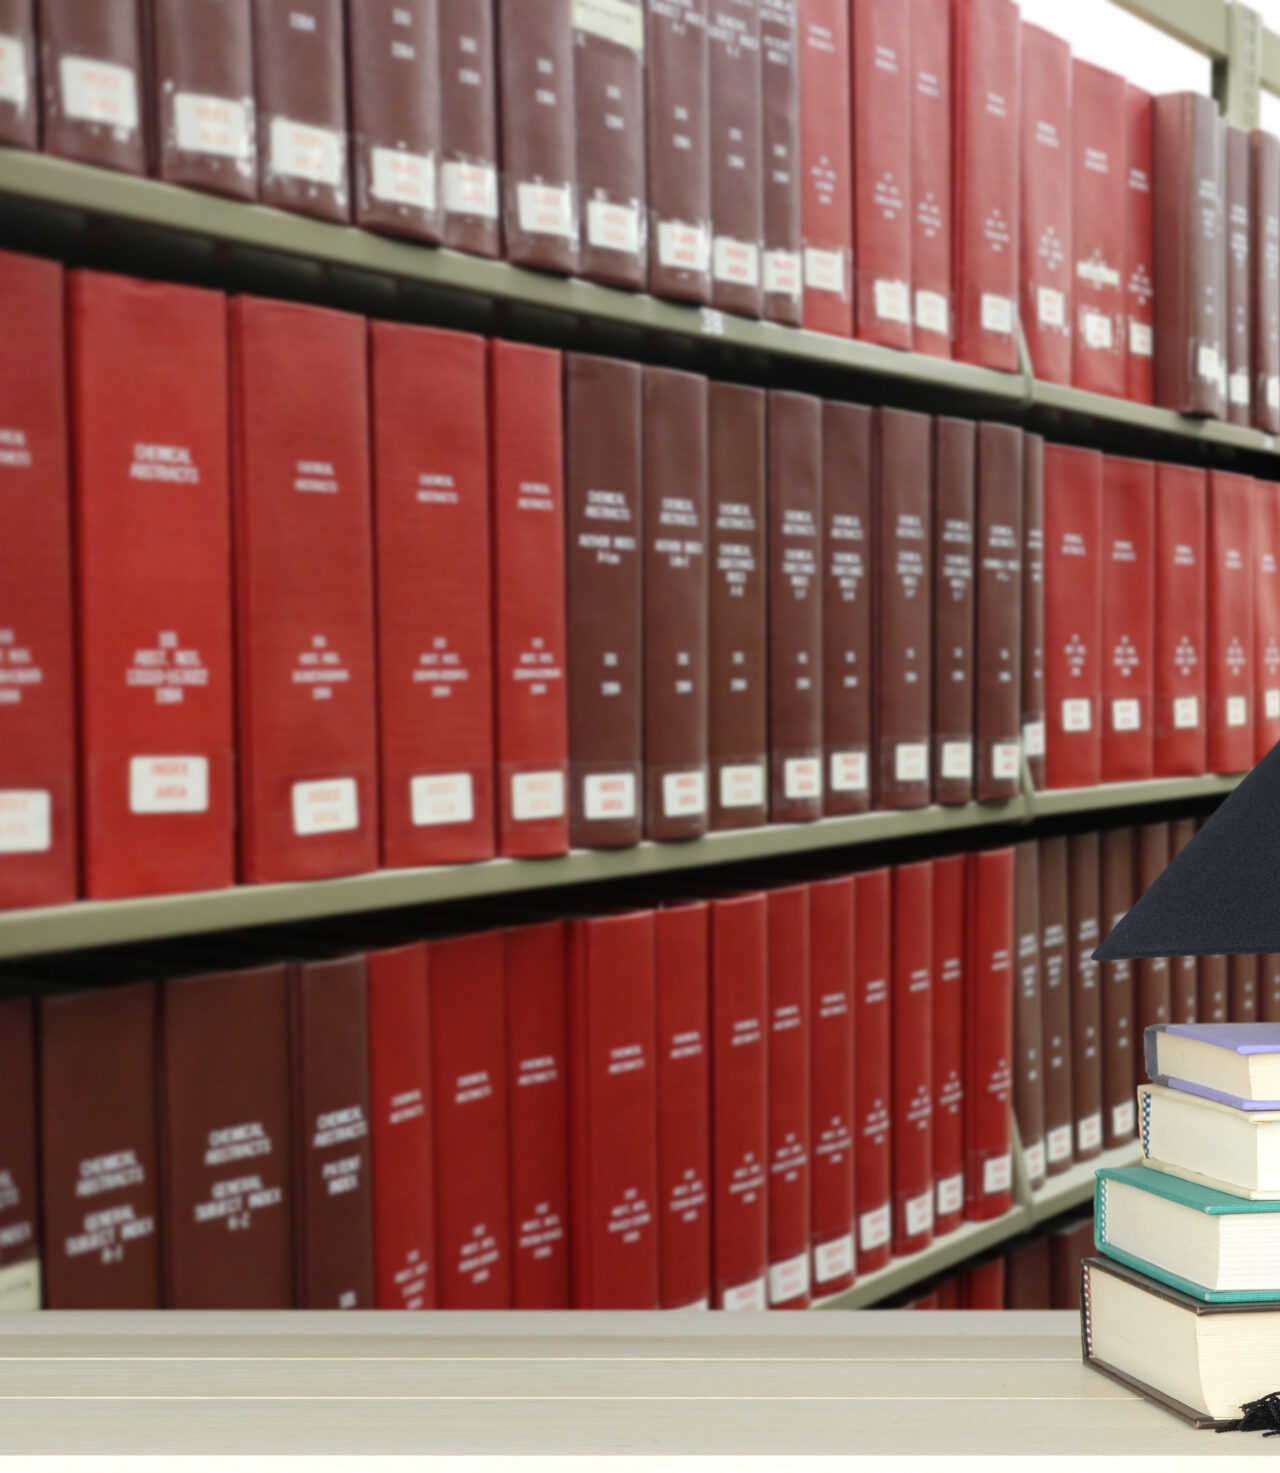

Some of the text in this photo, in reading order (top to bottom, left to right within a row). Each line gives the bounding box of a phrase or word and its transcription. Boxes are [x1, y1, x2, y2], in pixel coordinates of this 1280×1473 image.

[134, 442, 192, 465] CHEMICAL
[130, 462, 200, 484] ABSTRACTS
[208, 1121, 264, 1147] CHEMICAL
[80, 1150, 136, 1178] CHEMICAL
[205, 1138, 271, 1165] ABSTRACTS
[76, 1165, 144, 1197] ABSTRACTS
[212, 1175, 262, 1199] GENERAL
[84, 1204, 134, 1232] GENERAL
[195, 1196, 242, 1222] SUBJECT
[65, 1226, 115, 1256] SUBJECT
